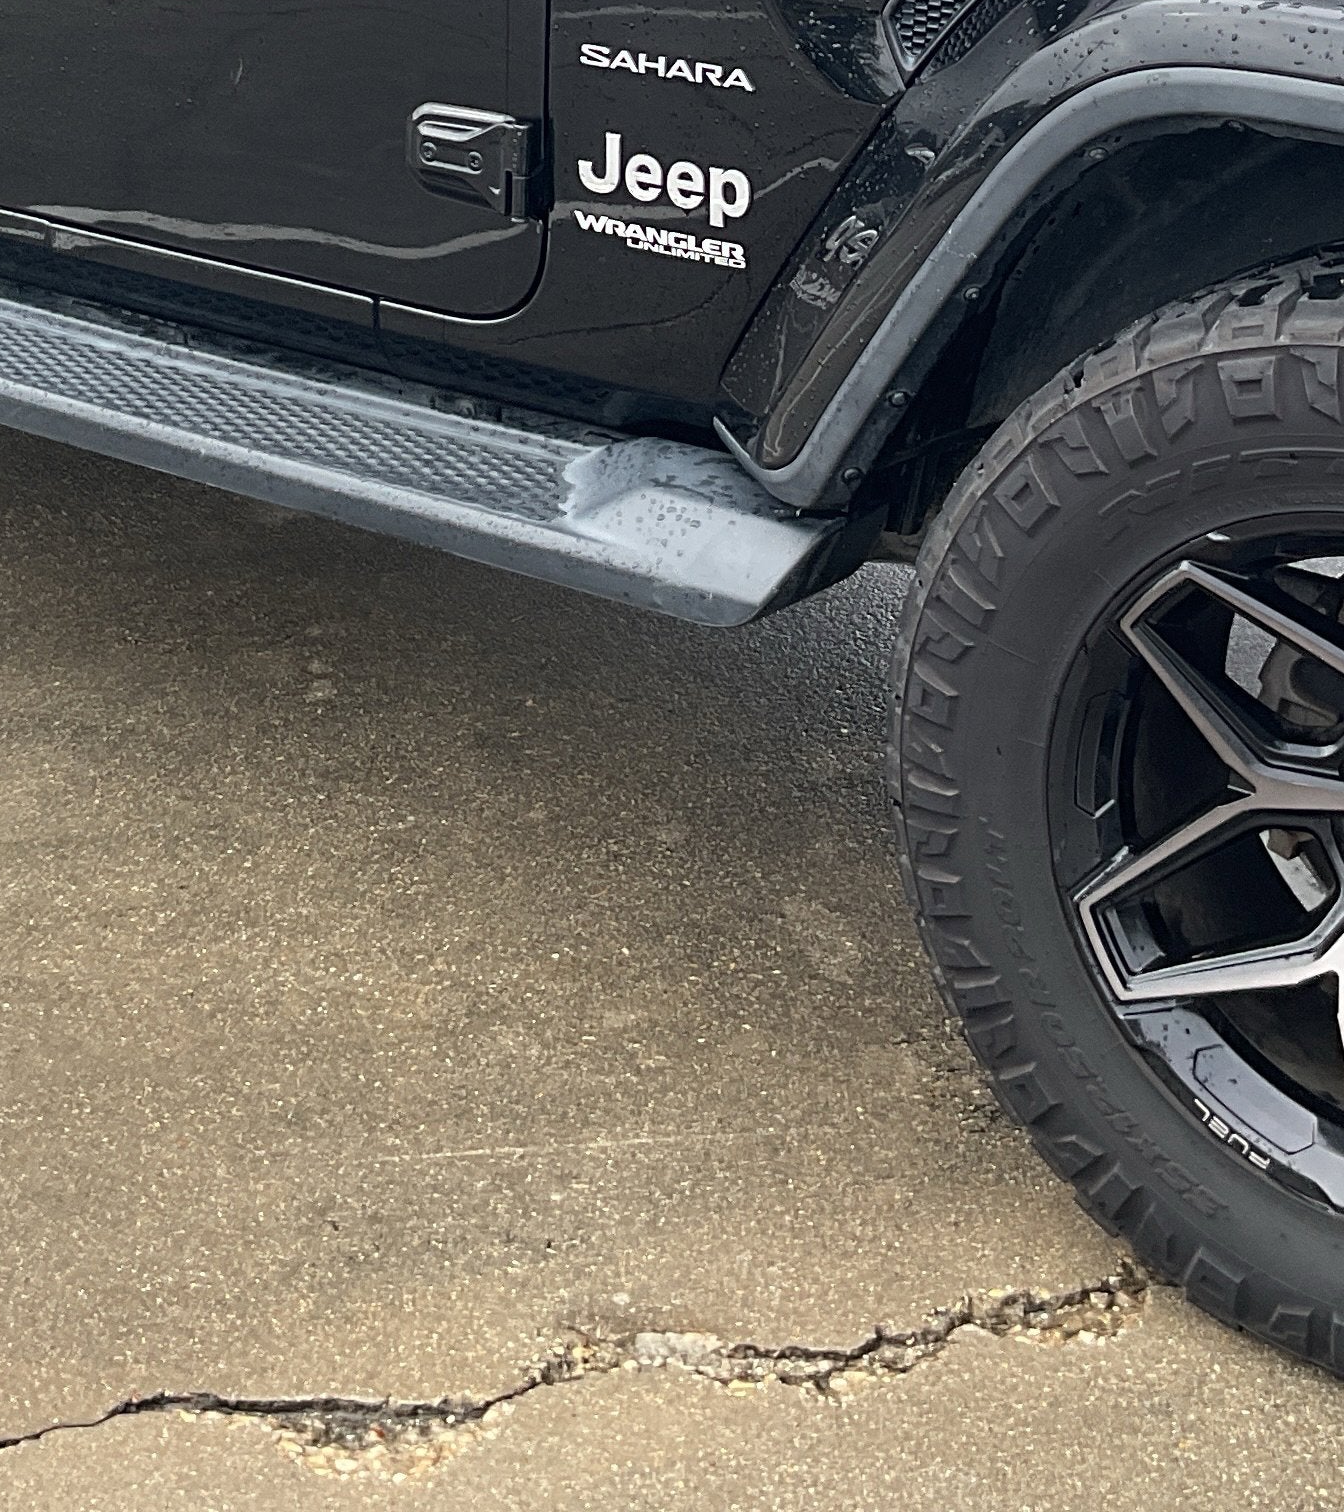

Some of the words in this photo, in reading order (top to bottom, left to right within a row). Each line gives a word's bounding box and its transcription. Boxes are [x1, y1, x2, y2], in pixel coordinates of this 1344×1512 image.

[579, 43, 756, 93] SAHARA
[577, 131, 751, 228] Jeep
[573, 209, 746, 260] WRANGLER
[625, 237, 747, 270] UNLIMITED
[1193, 1097, 1271, 1170] FUEL
